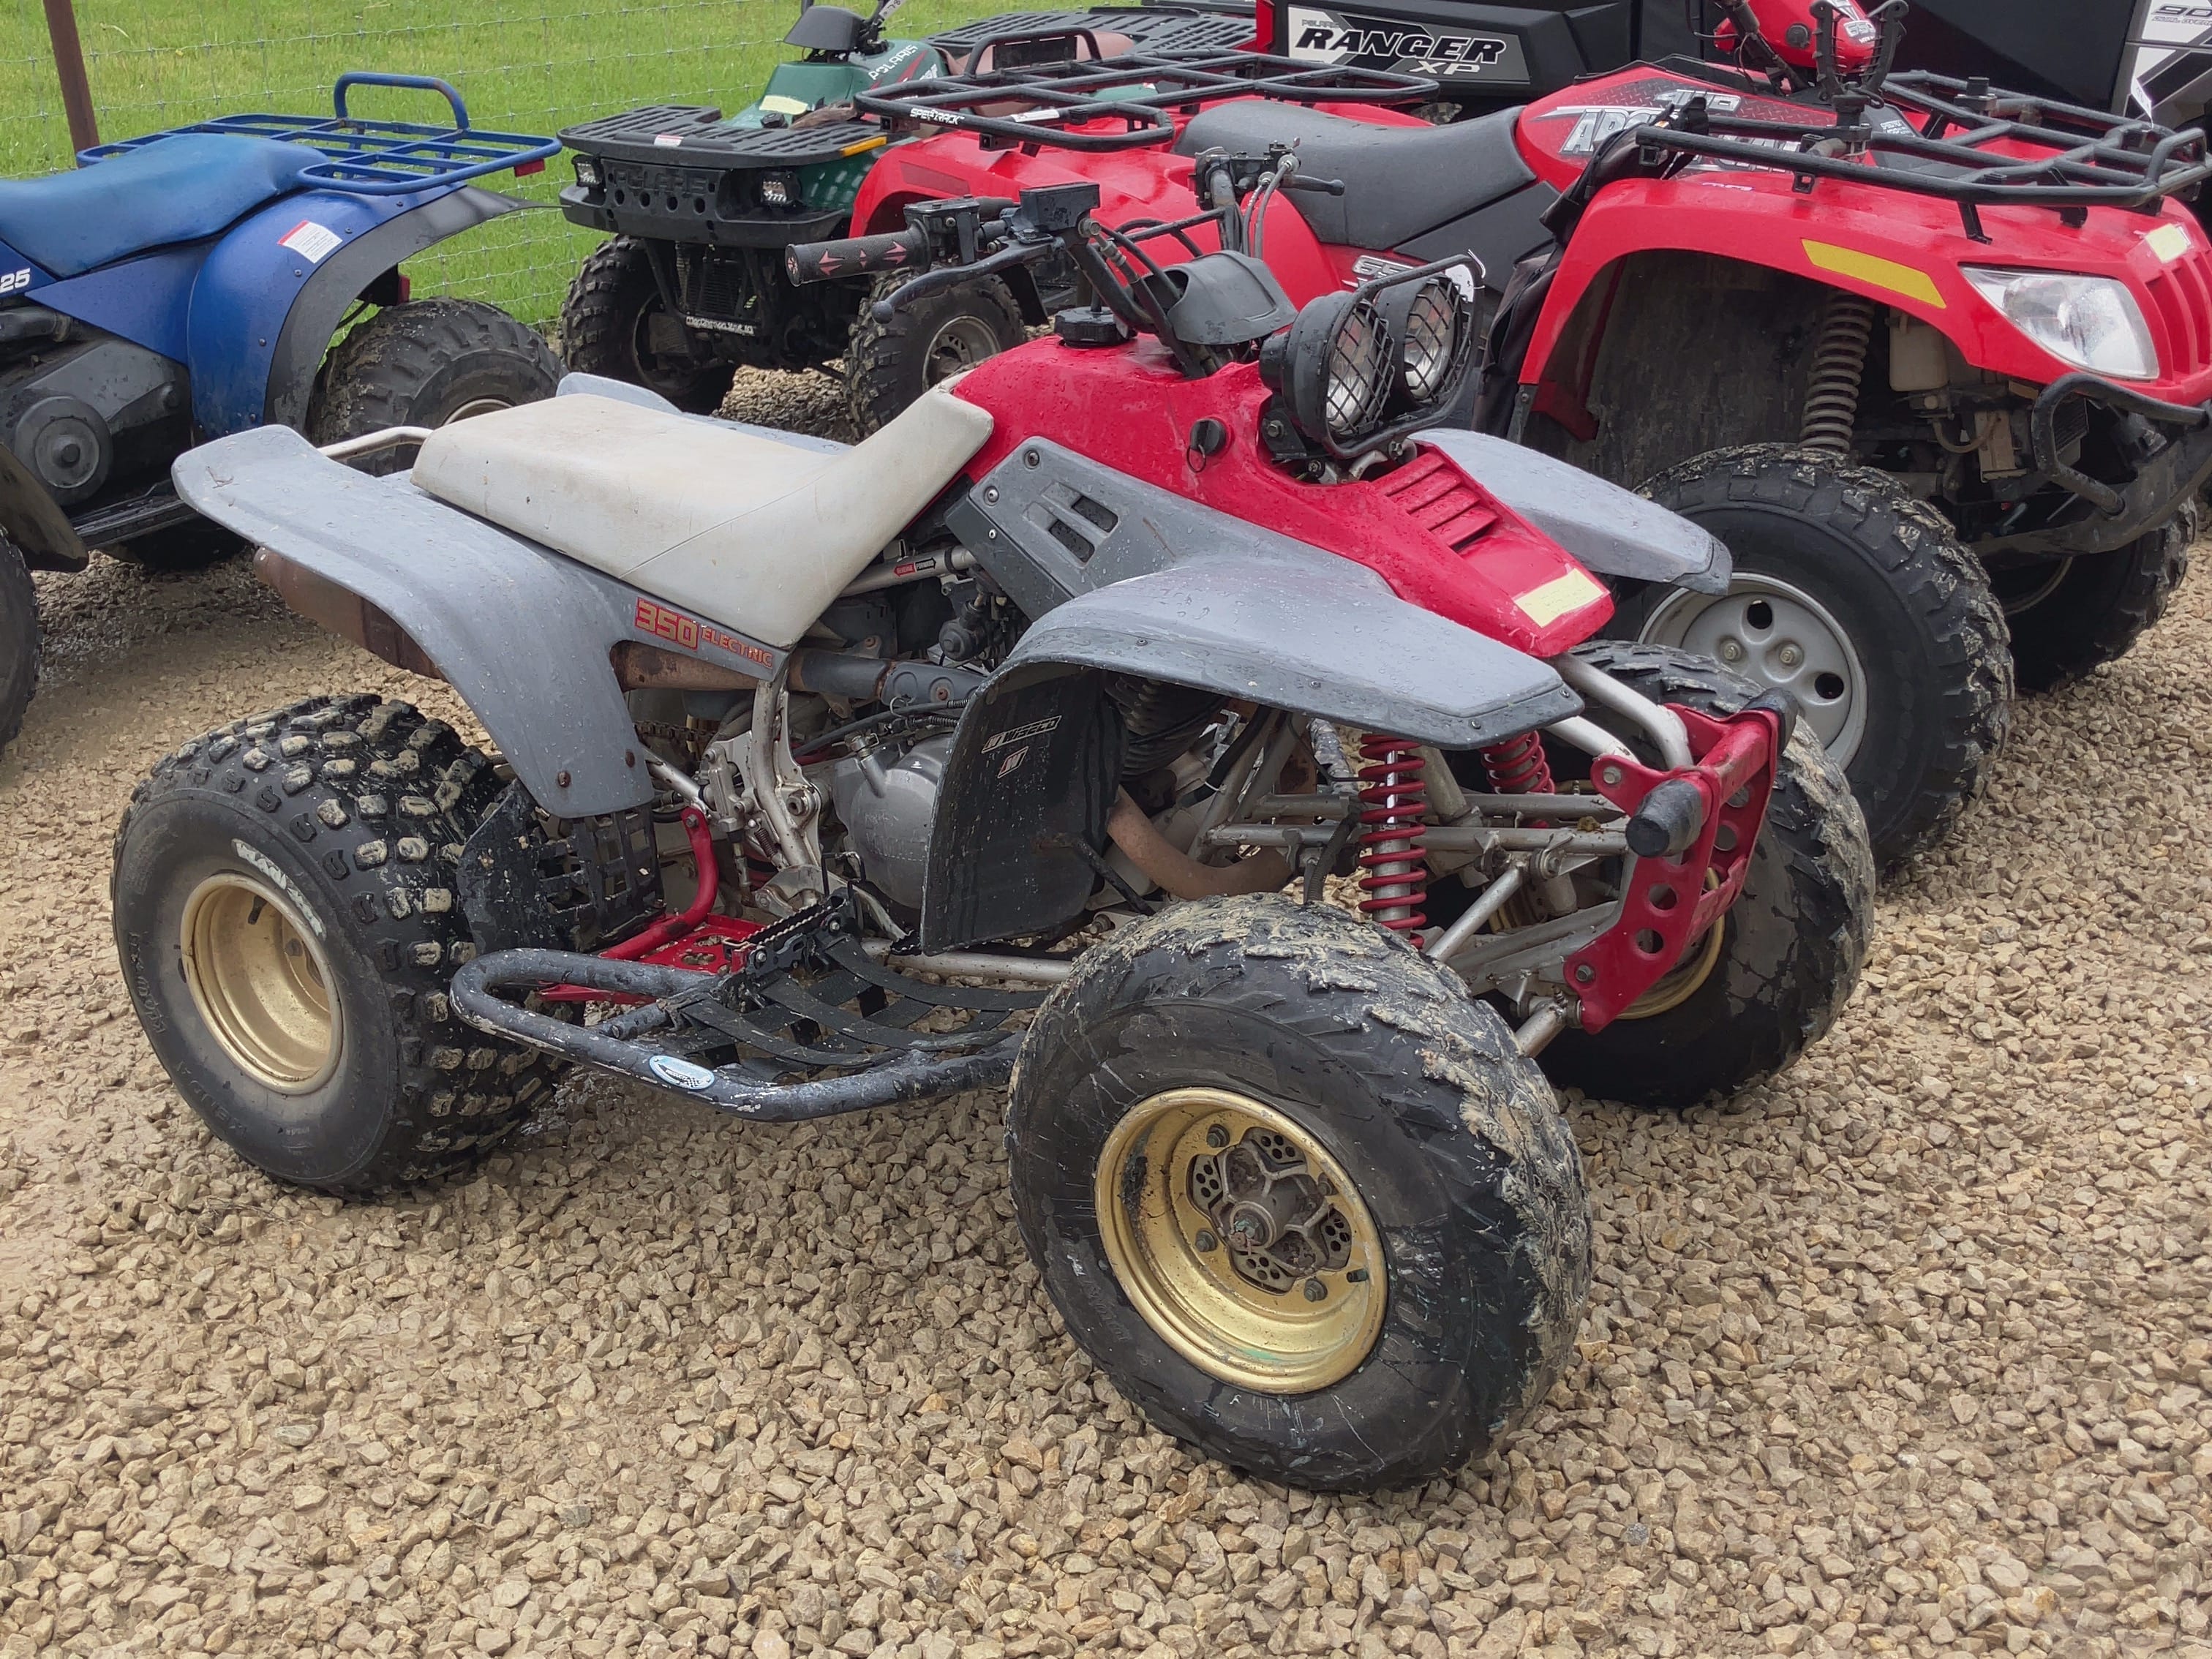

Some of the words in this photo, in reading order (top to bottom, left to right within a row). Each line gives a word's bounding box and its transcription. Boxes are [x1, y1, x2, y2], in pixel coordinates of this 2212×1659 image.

[868, 44, 919, 80] POLARIS
[1295, 27, 1507, 64] RANGER
[1408, 61, 1481, 75] XP
[635, 598, 699, 650] 350
[700, 625, 774, 669] ELECTRIC
